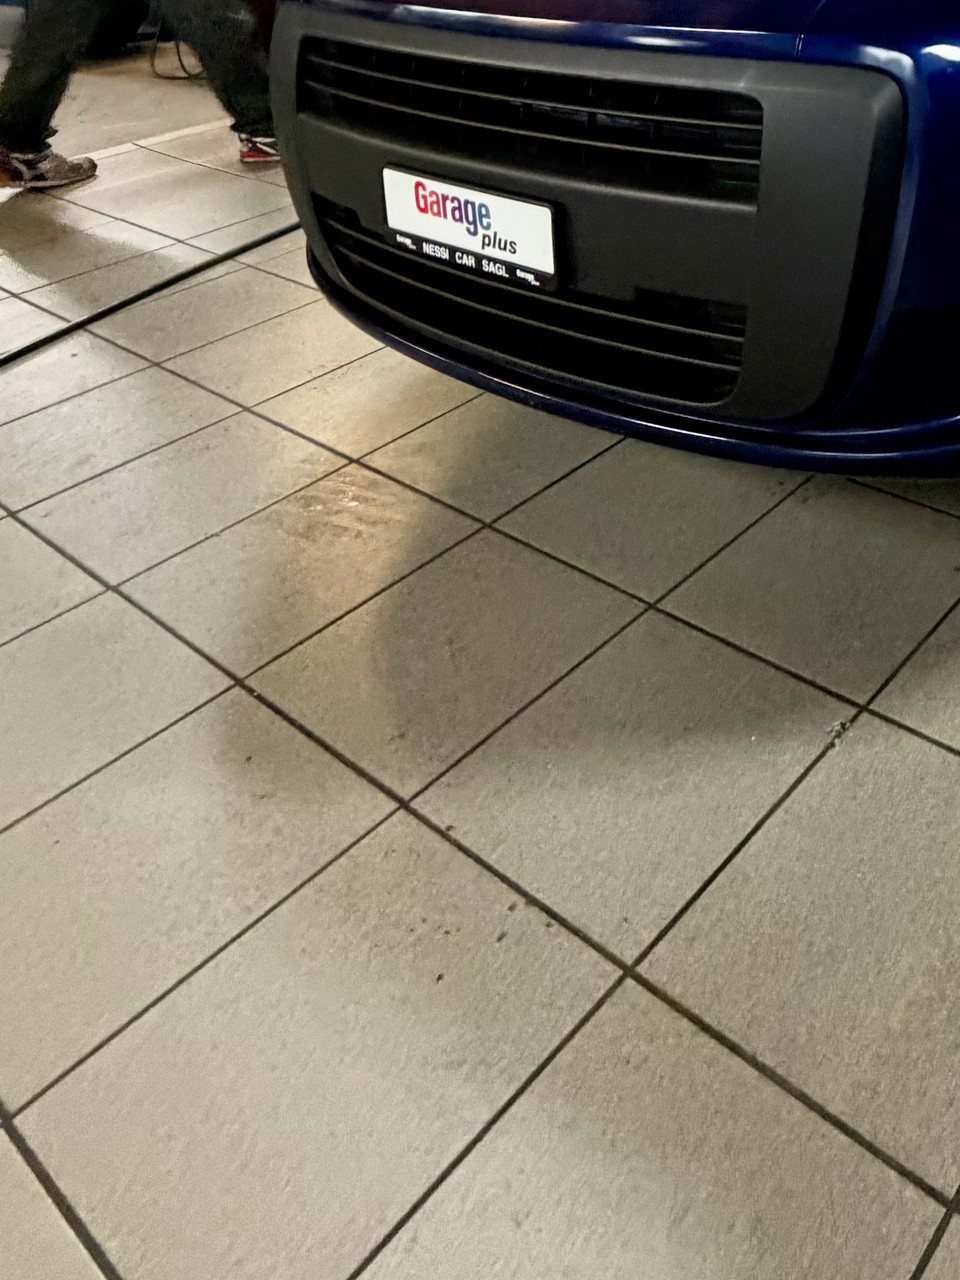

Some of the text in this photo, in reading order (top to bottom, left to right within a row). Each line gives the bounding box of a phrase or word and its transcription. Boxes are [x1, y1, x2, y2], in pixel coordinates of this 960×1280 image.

[413, 180, 492, 237] Garage
[422, 241, 450, 261] NESSI
[455, 251, 476, 269] CAR
[481, 258, 510, 278] SAGL
[481, 230, 518, 255] plus
